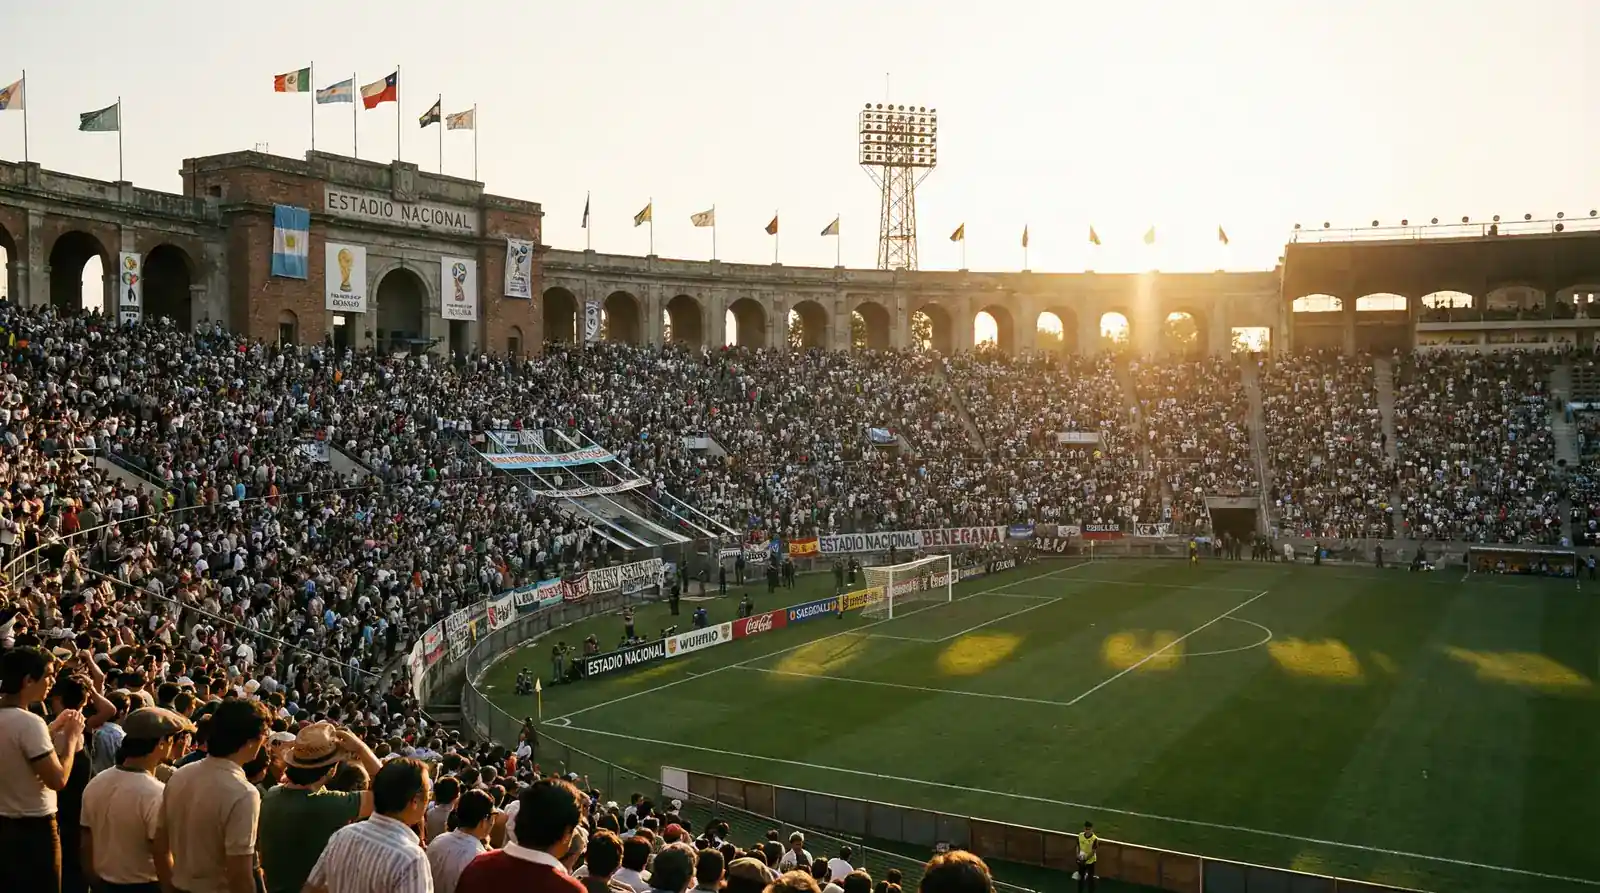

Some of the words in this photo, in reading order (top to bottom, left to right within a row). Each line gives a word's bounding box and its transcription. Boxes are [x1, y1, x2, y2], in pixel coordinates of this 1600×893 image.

[328, 192, 393, 217] ESTADIO
[401, 205, 472, 229] NACIONAL
[819, 534, 864, 551] ESTADIO
[865, 532, 918, 549] NACIONAL
[588, 656, 623, 676] ESTADIO
[624, 643, 665, 666] NACIONAL
